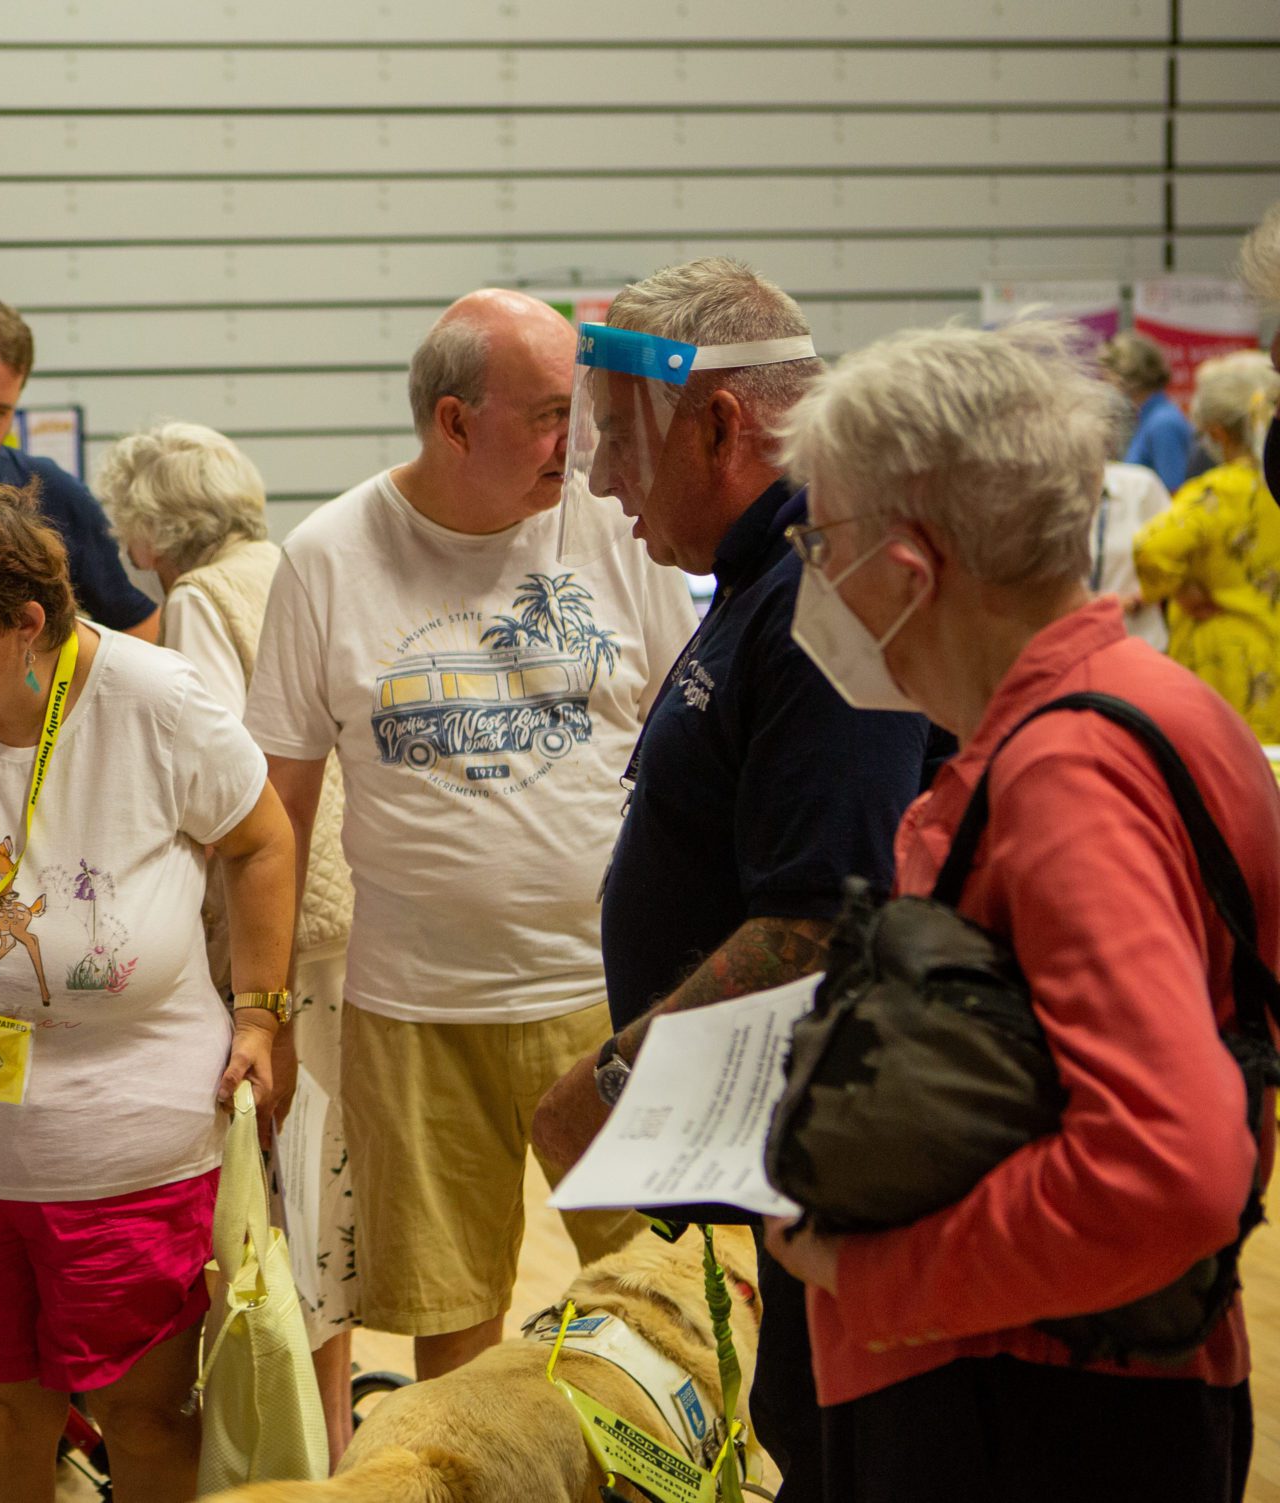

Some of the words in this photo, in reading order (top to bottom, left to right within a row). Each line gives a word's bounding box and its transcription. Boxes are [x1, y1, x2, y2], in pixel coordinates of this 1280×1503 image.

[397, 619, 443, 655] SUNSHINE
[449, 612, 483, 622] STATE
[46, 681, 68, 738] Visually
[444, 709, 507, 752] West
[512, 708, 551, 749] Surf
[379, 716, 437, 759] Pacific
[31, 741, 52, 805] Impaired
[427, 773, 489, 797] SACREMENTO
[503, 761, 554, 796] CALIFORNIA
[474, 768, 502, 777] 1976
[600, 1422, 658, 1464] working
[621, 1425, 655, 1452] dog!
[657, 1450, 699, 1479] guide
